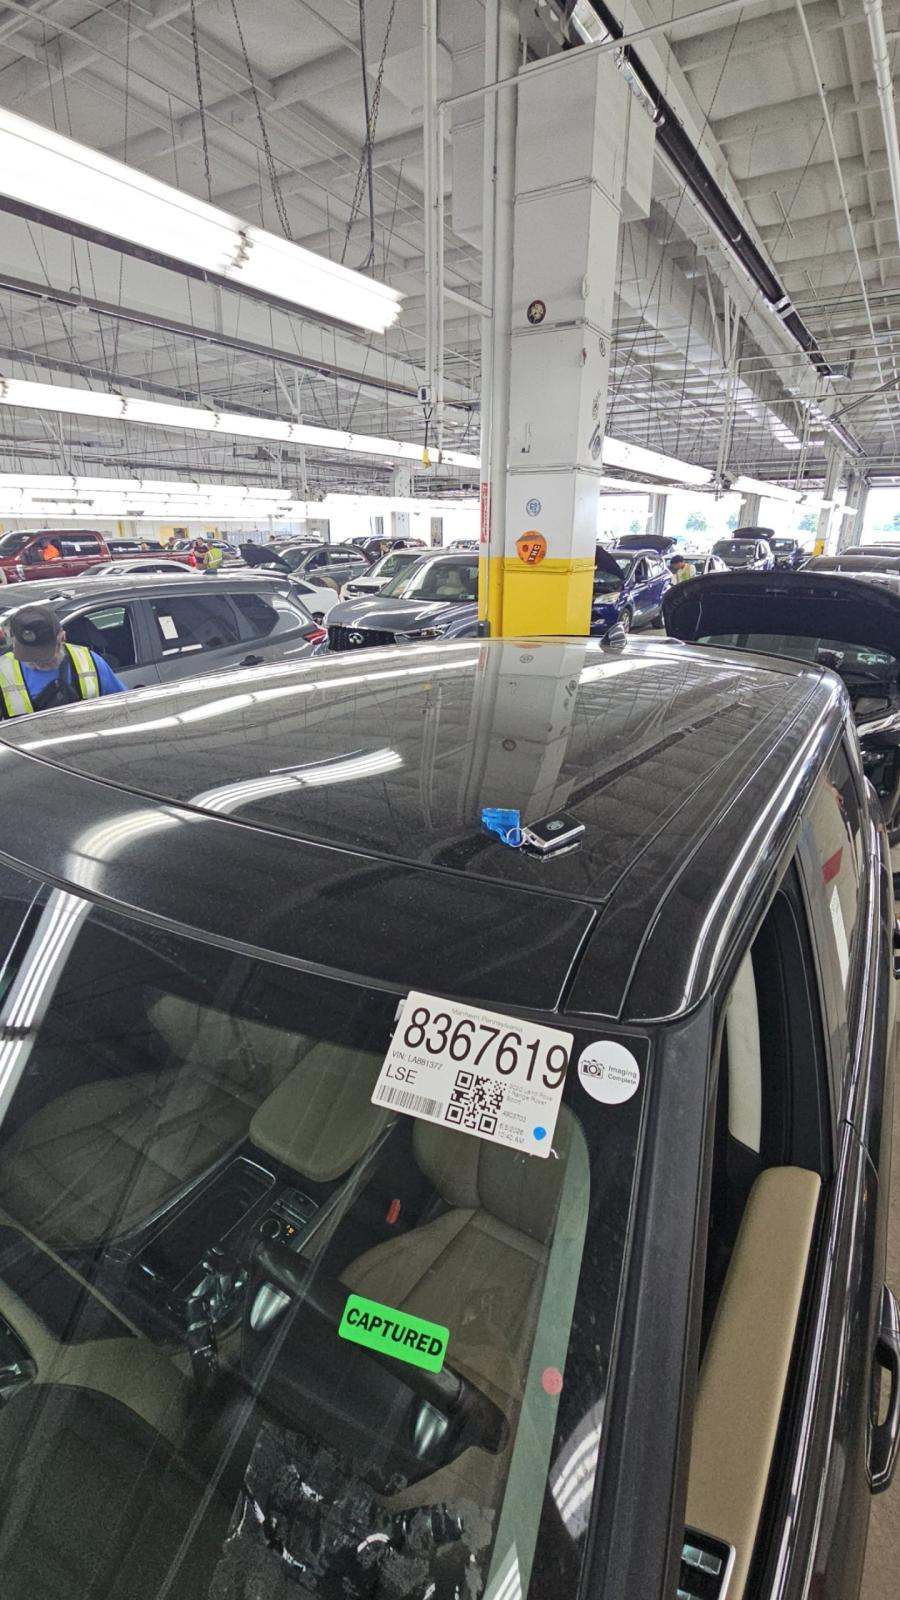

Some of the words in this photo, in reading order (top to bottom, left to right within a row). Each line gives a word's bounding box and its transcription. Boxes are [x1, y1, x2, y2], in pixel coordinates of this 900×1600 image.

[392, 1051, 408, 1062] VIN:
[404, 1007, 569, 1090] 8367619
[386, 1064, 418, 1085] LSE
[607, 1074, 637, 1086] Complete
[608, 1064, 638, 1080] Imaging
[346, 1308, 443, 1356] CAPTURED
